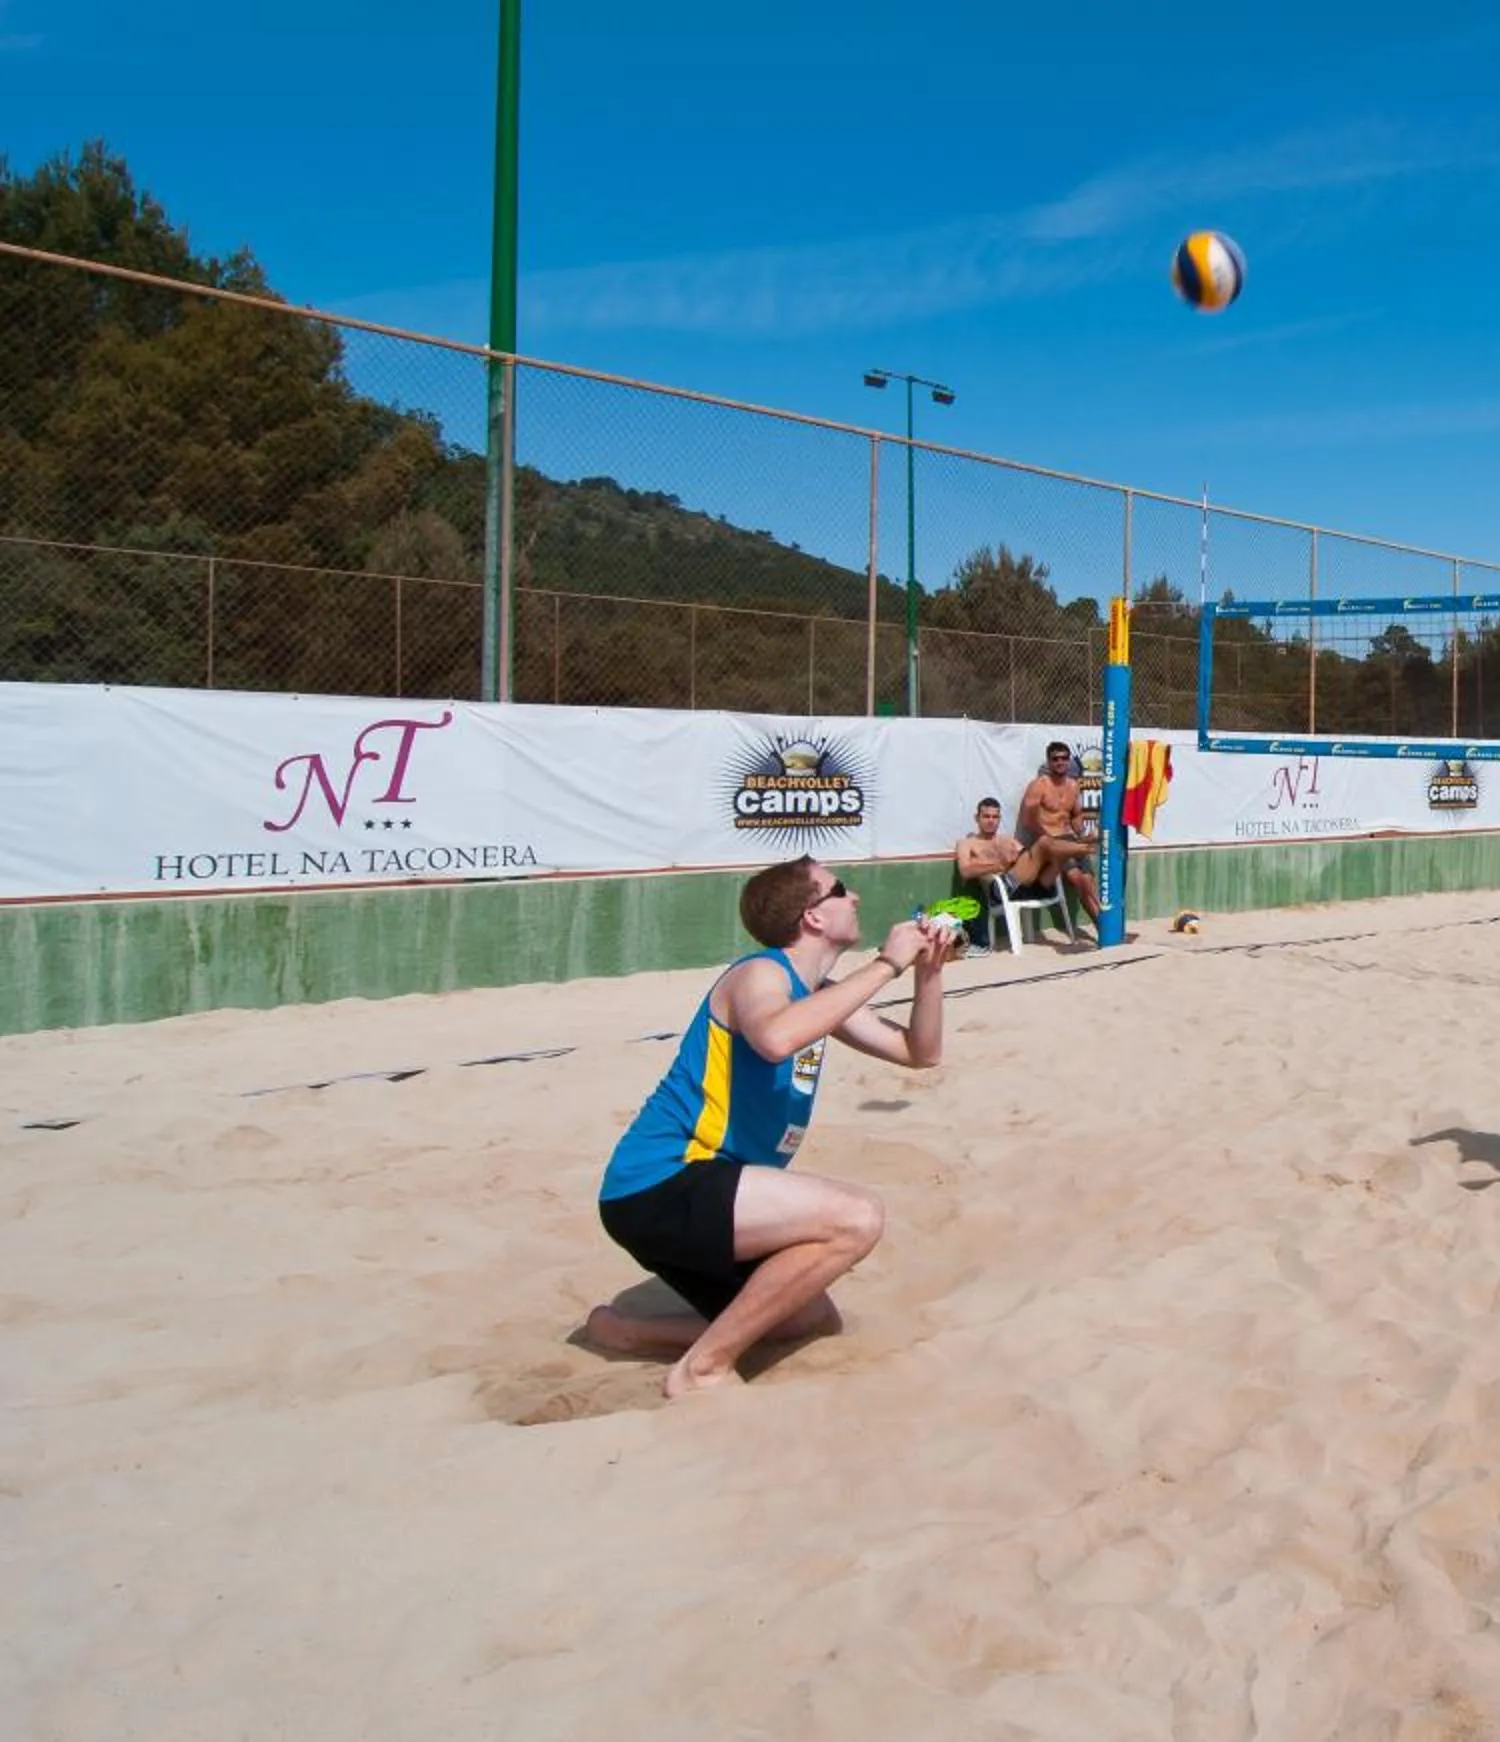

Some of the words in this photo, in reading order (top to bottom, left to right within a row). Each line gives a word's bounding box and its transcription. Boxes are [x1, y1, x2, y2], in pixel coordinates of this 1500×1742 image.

[746, 776, 850, 789] BEACHVOLLEY
[1429, 785, 1477, 802] camps
[737, 789, 860, 816] camps
[1234, 821, 1279, 836] HOTEL
[155, 852, 289, 880] HOTEL
[300, 851, 352, 875] NA
[362, 845, 538, 873] TACONERA
